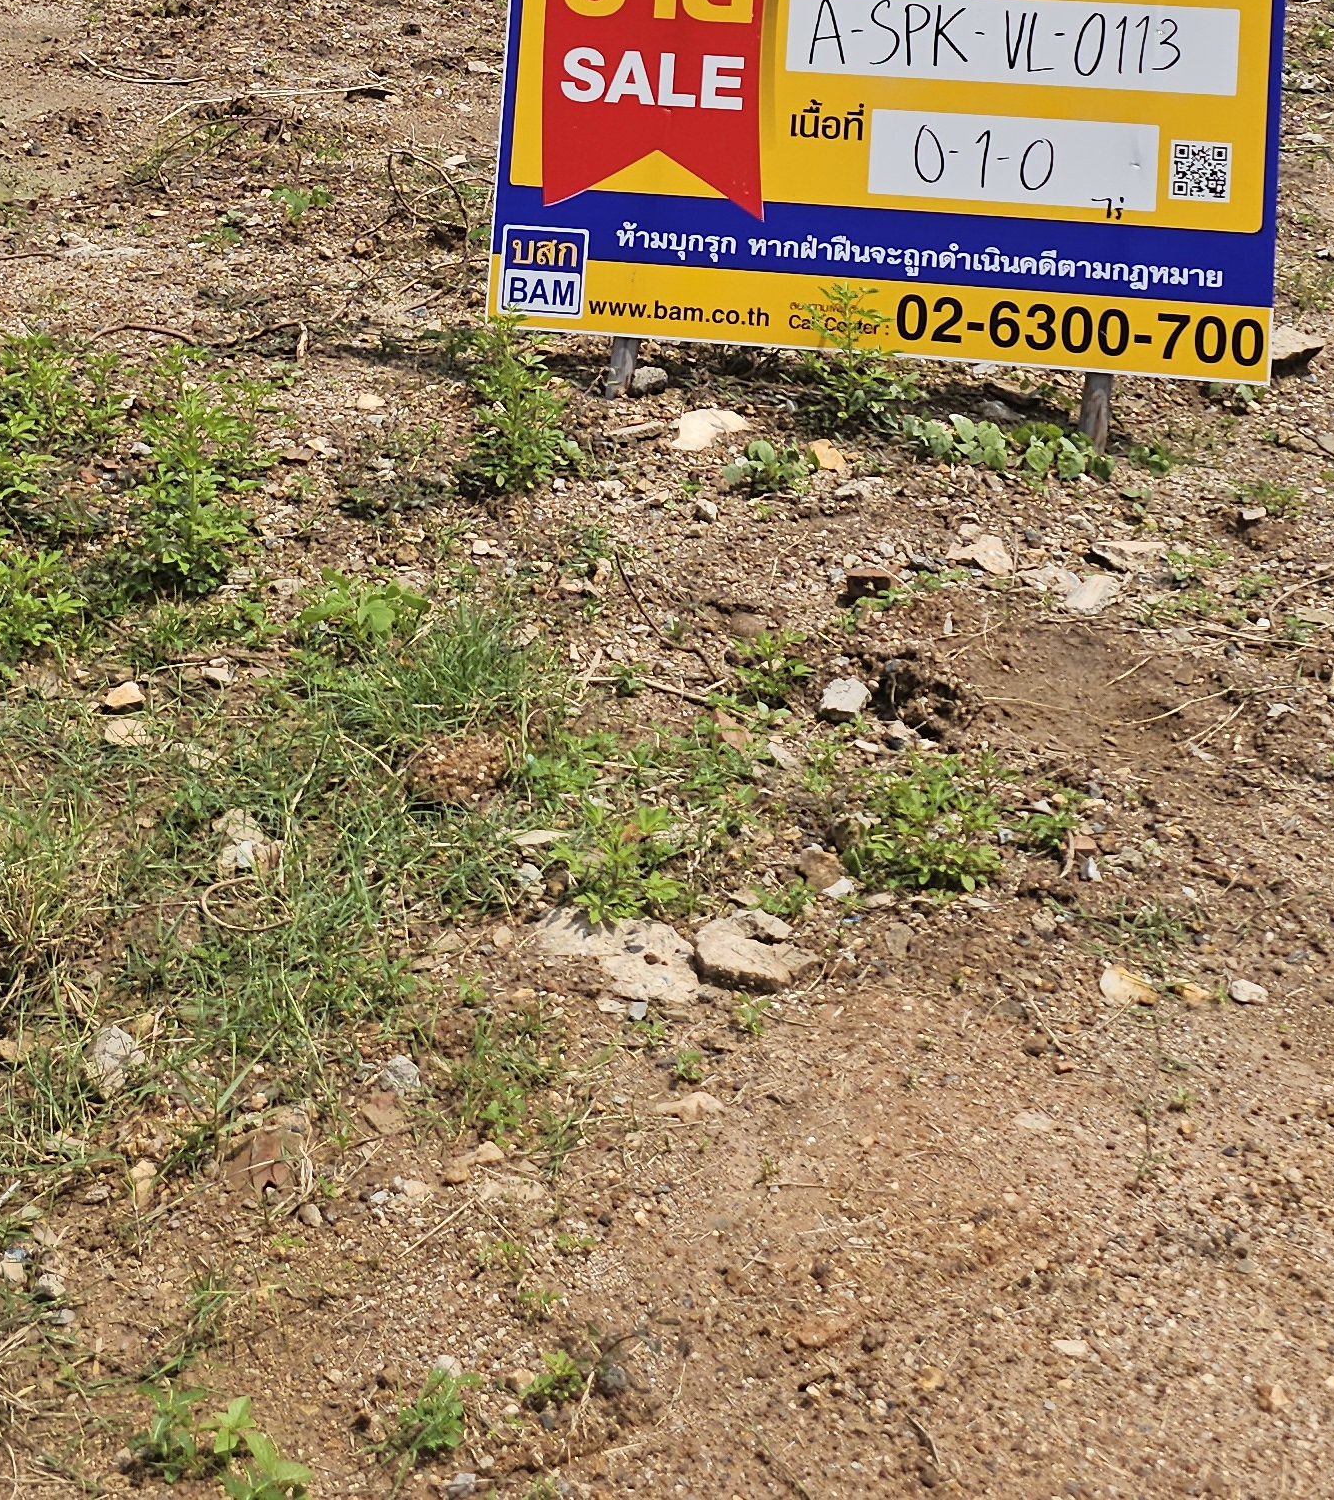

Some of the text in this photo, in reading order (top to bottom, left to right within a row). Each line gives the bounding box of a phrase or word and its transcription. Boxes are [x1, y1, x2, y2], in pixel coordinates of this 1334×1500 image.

[560, 46, 745, 111] SALE
[789, 99, 865, 141] เนื้อที่
[511, 239, 578, 268] บสก
[616, 221, 737, 263] ห้ามบุกรุก
[509, 276, 575, 307] BAM
[588, 299, 770, 328] www.bam.co.th
[895, 293, 1264, 368] 02-6300-700
